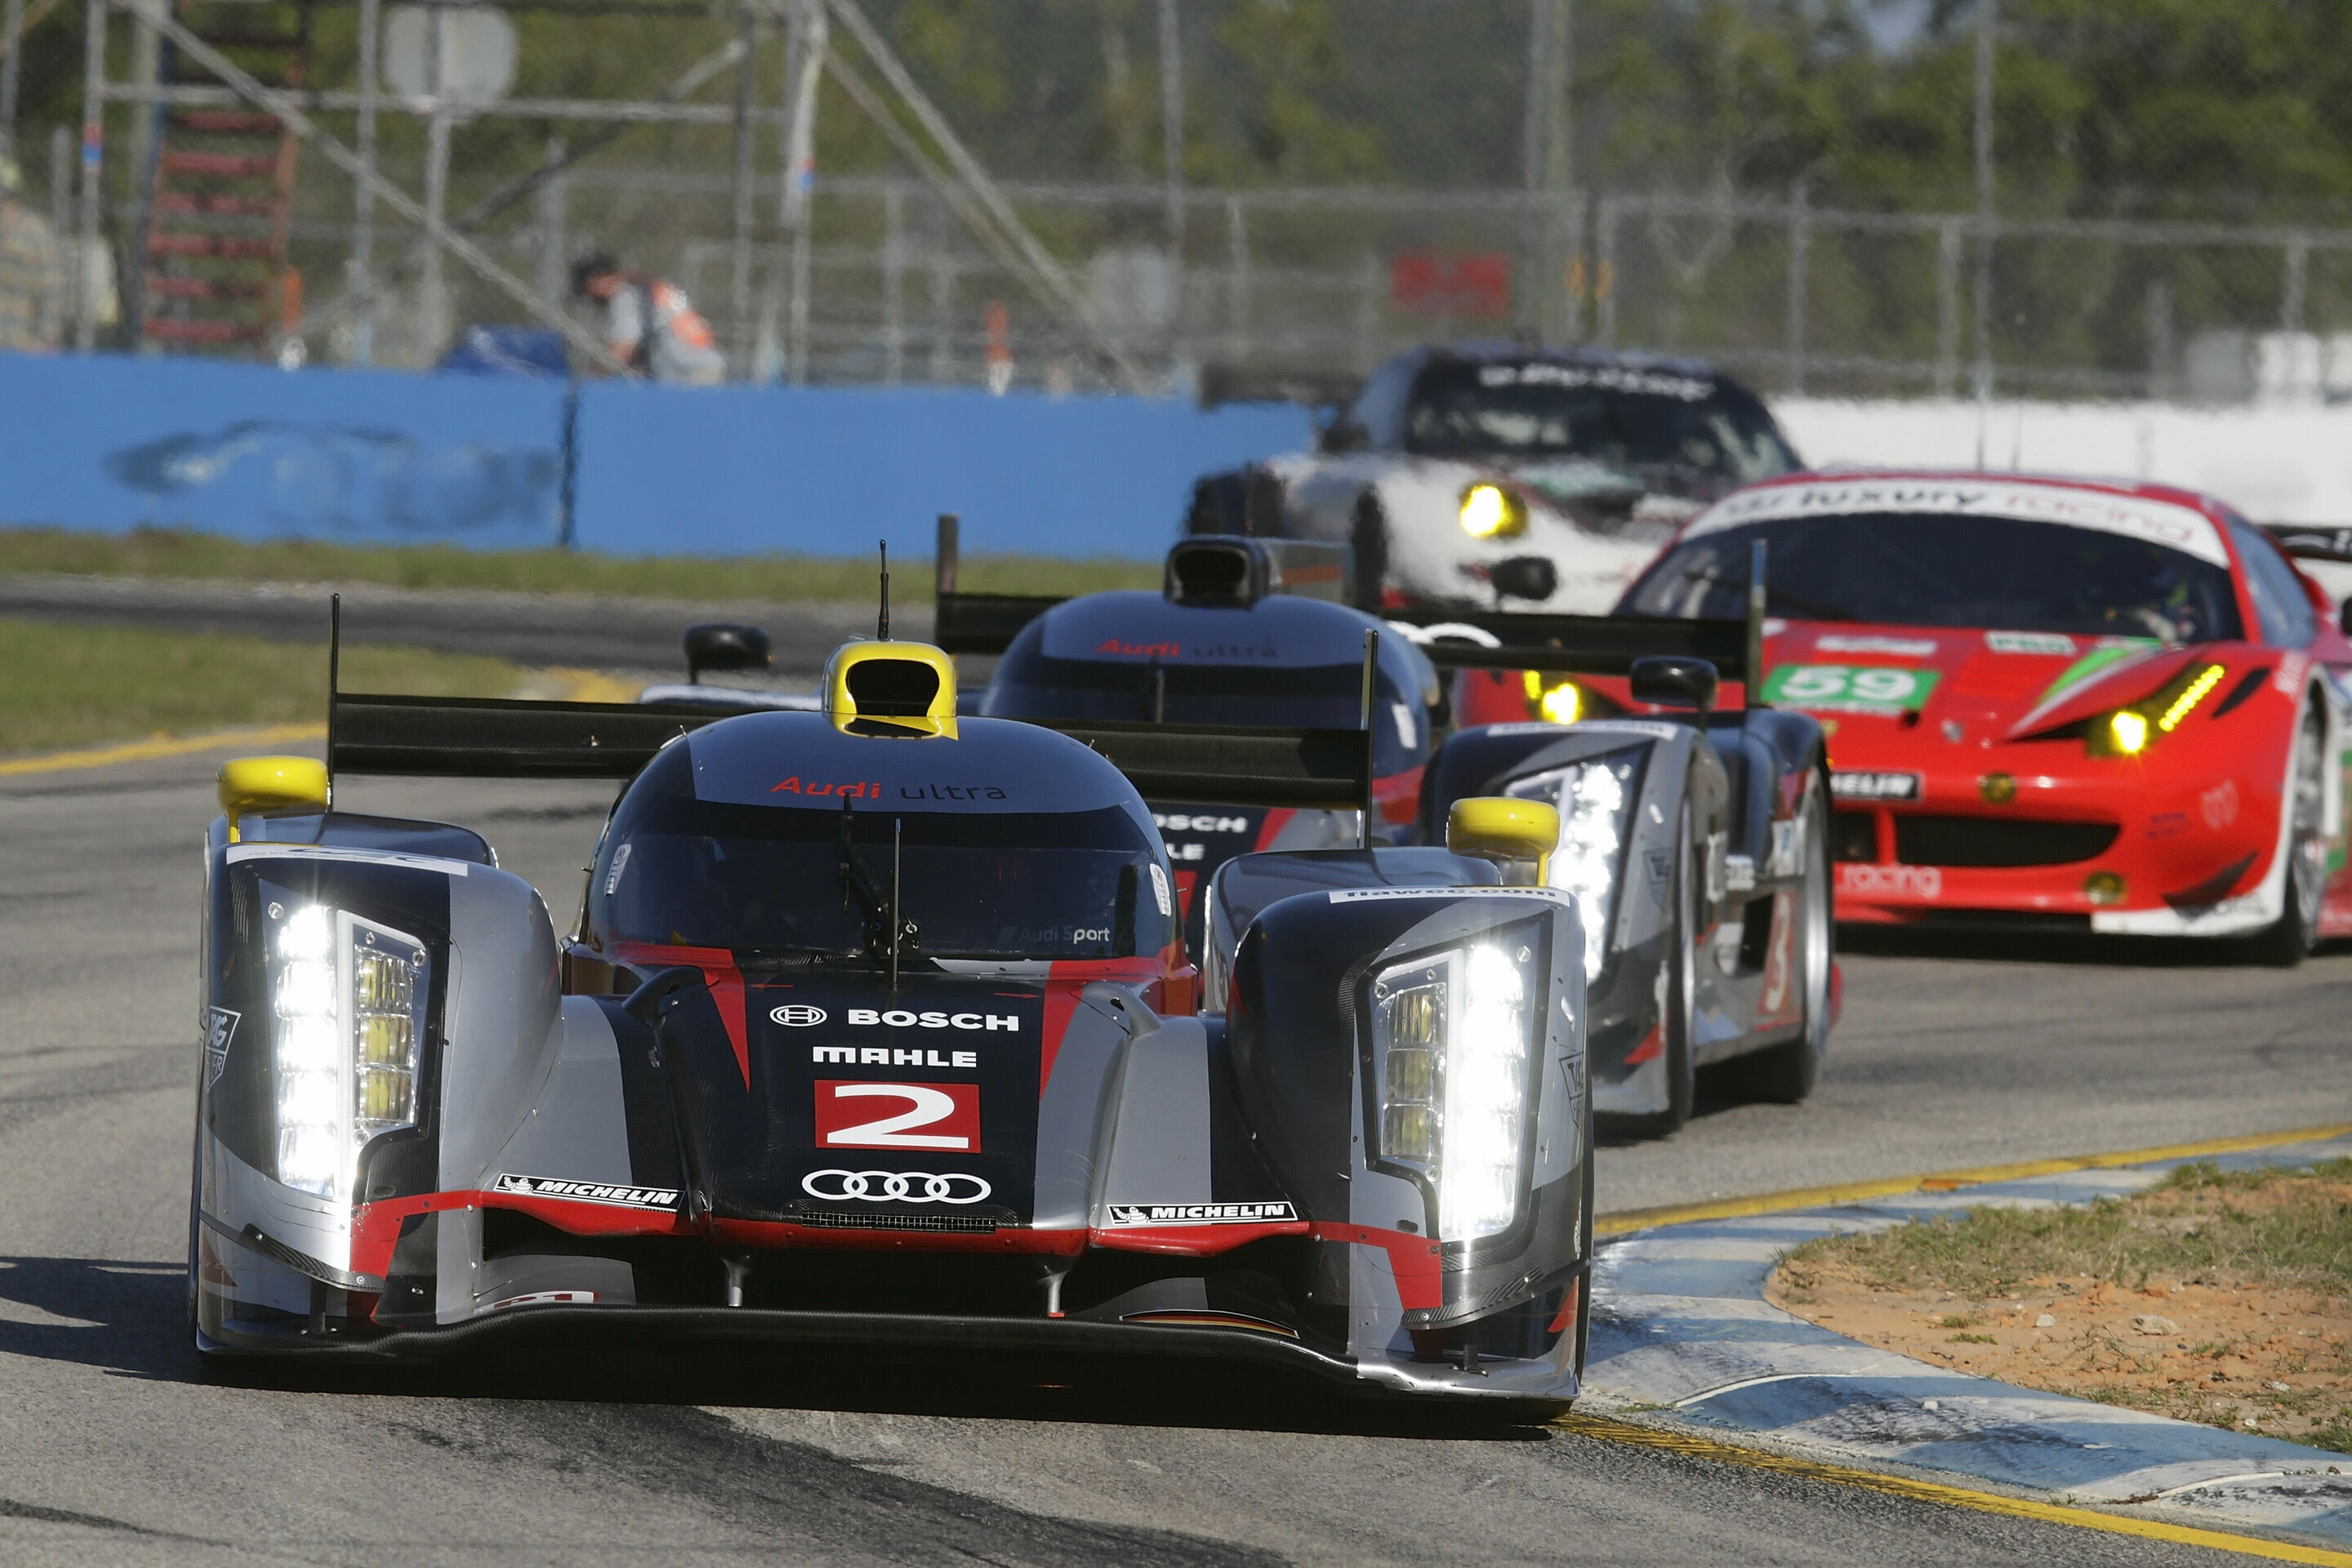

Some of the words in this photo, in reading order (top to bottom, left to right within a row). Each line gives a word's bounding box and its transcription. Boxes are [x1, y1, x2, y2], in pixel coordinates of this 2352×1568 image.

[1802, 488, 1984, 510] luxury
[2006, 492, 2192, 542] racing
[1095, 637, 1181, 657] Audi
[1780, 666, 1917, 701] 59
[770, 776, 881, 799] Audi
[901, 783, 1006, 800] ultra
[1063, 926, 1110, 944] Sport
[849, 1009, 1018, 1031] BOSCH
[813, 1046, 977, 1067] MAHLE
[826, 1084, 969, 1149] 2
[537, 1181, 678, 1205] MICHELIN
[1151, 1205, 1285, 1218] MICHELIN
